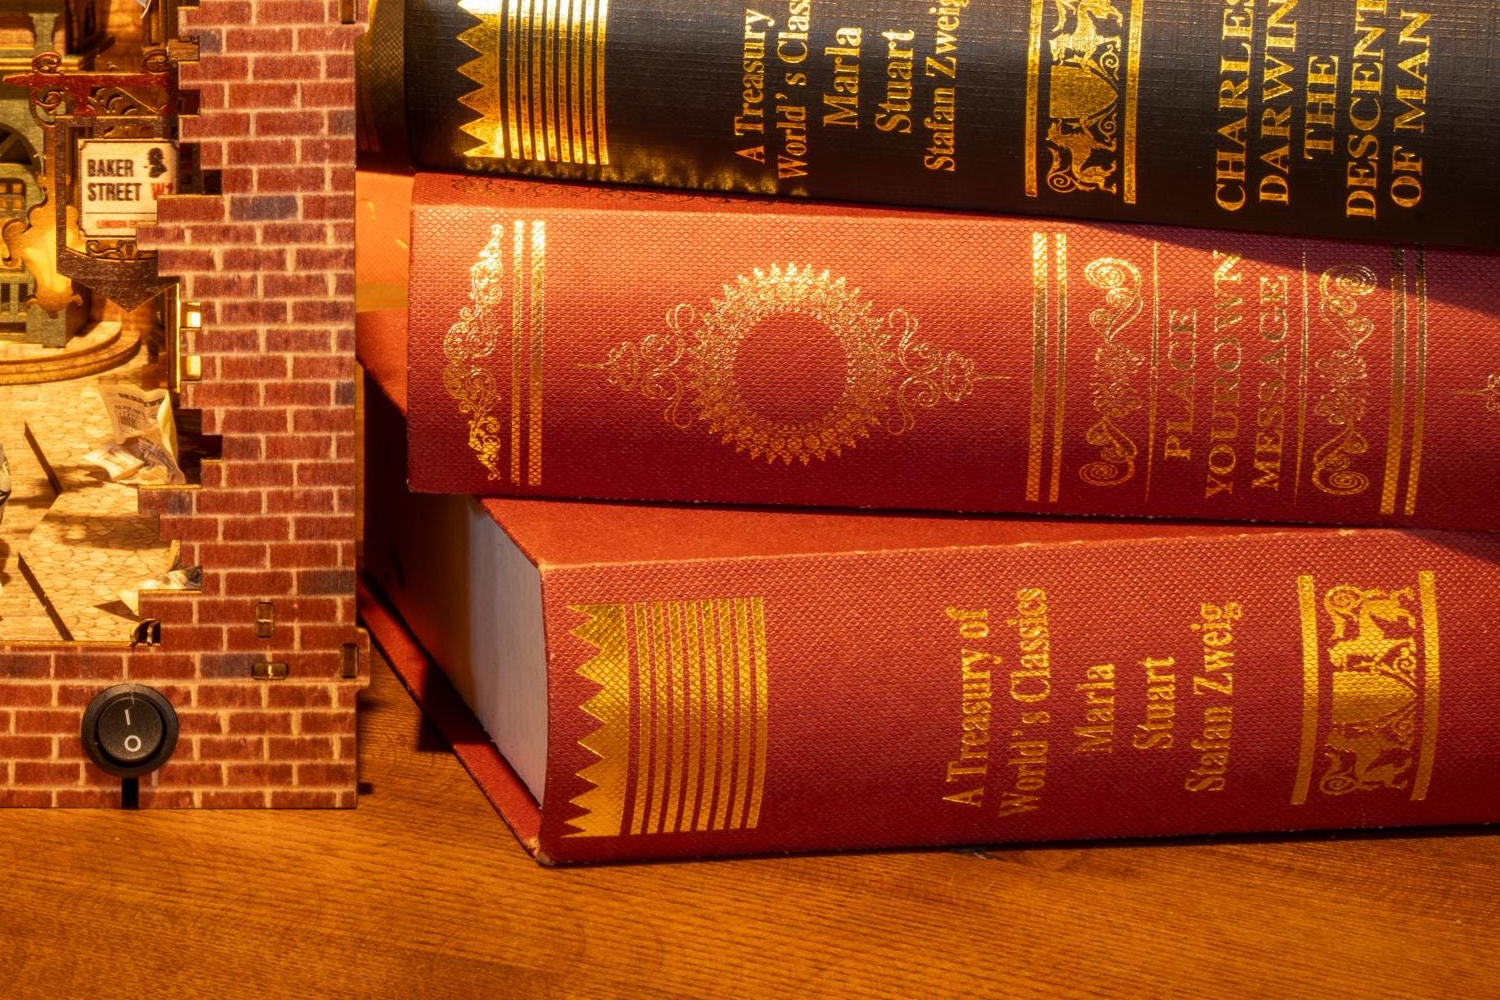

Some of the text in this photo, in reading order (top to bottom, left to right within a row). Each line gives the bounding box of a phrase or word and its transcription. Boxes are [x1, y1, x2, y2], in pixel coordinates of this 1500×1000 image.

[733, 8, 775, 137] Treasury
[823, 27, 862, 129] Marla
[874, 29, 916, 134] Stuart
[1303, 54, 1340, 160] THE
[1390, 7, 1432, 208] OF MAN
[87, 159, 135, 177] BAKER
[734, 145, 766, 165] A
[923, 86, 957, 172] Stafan
[87, 182, 142, 202] STREET
[1163, 306, 1199, 461] PLACE
[1251, 274, 1290, 492] MESSAGE
[942, 606, 1002, 807] A Treasury of
[1132, 656, 1176, 749] Stuart
[1185, 601, 1242, 792] Stafan Zweig
